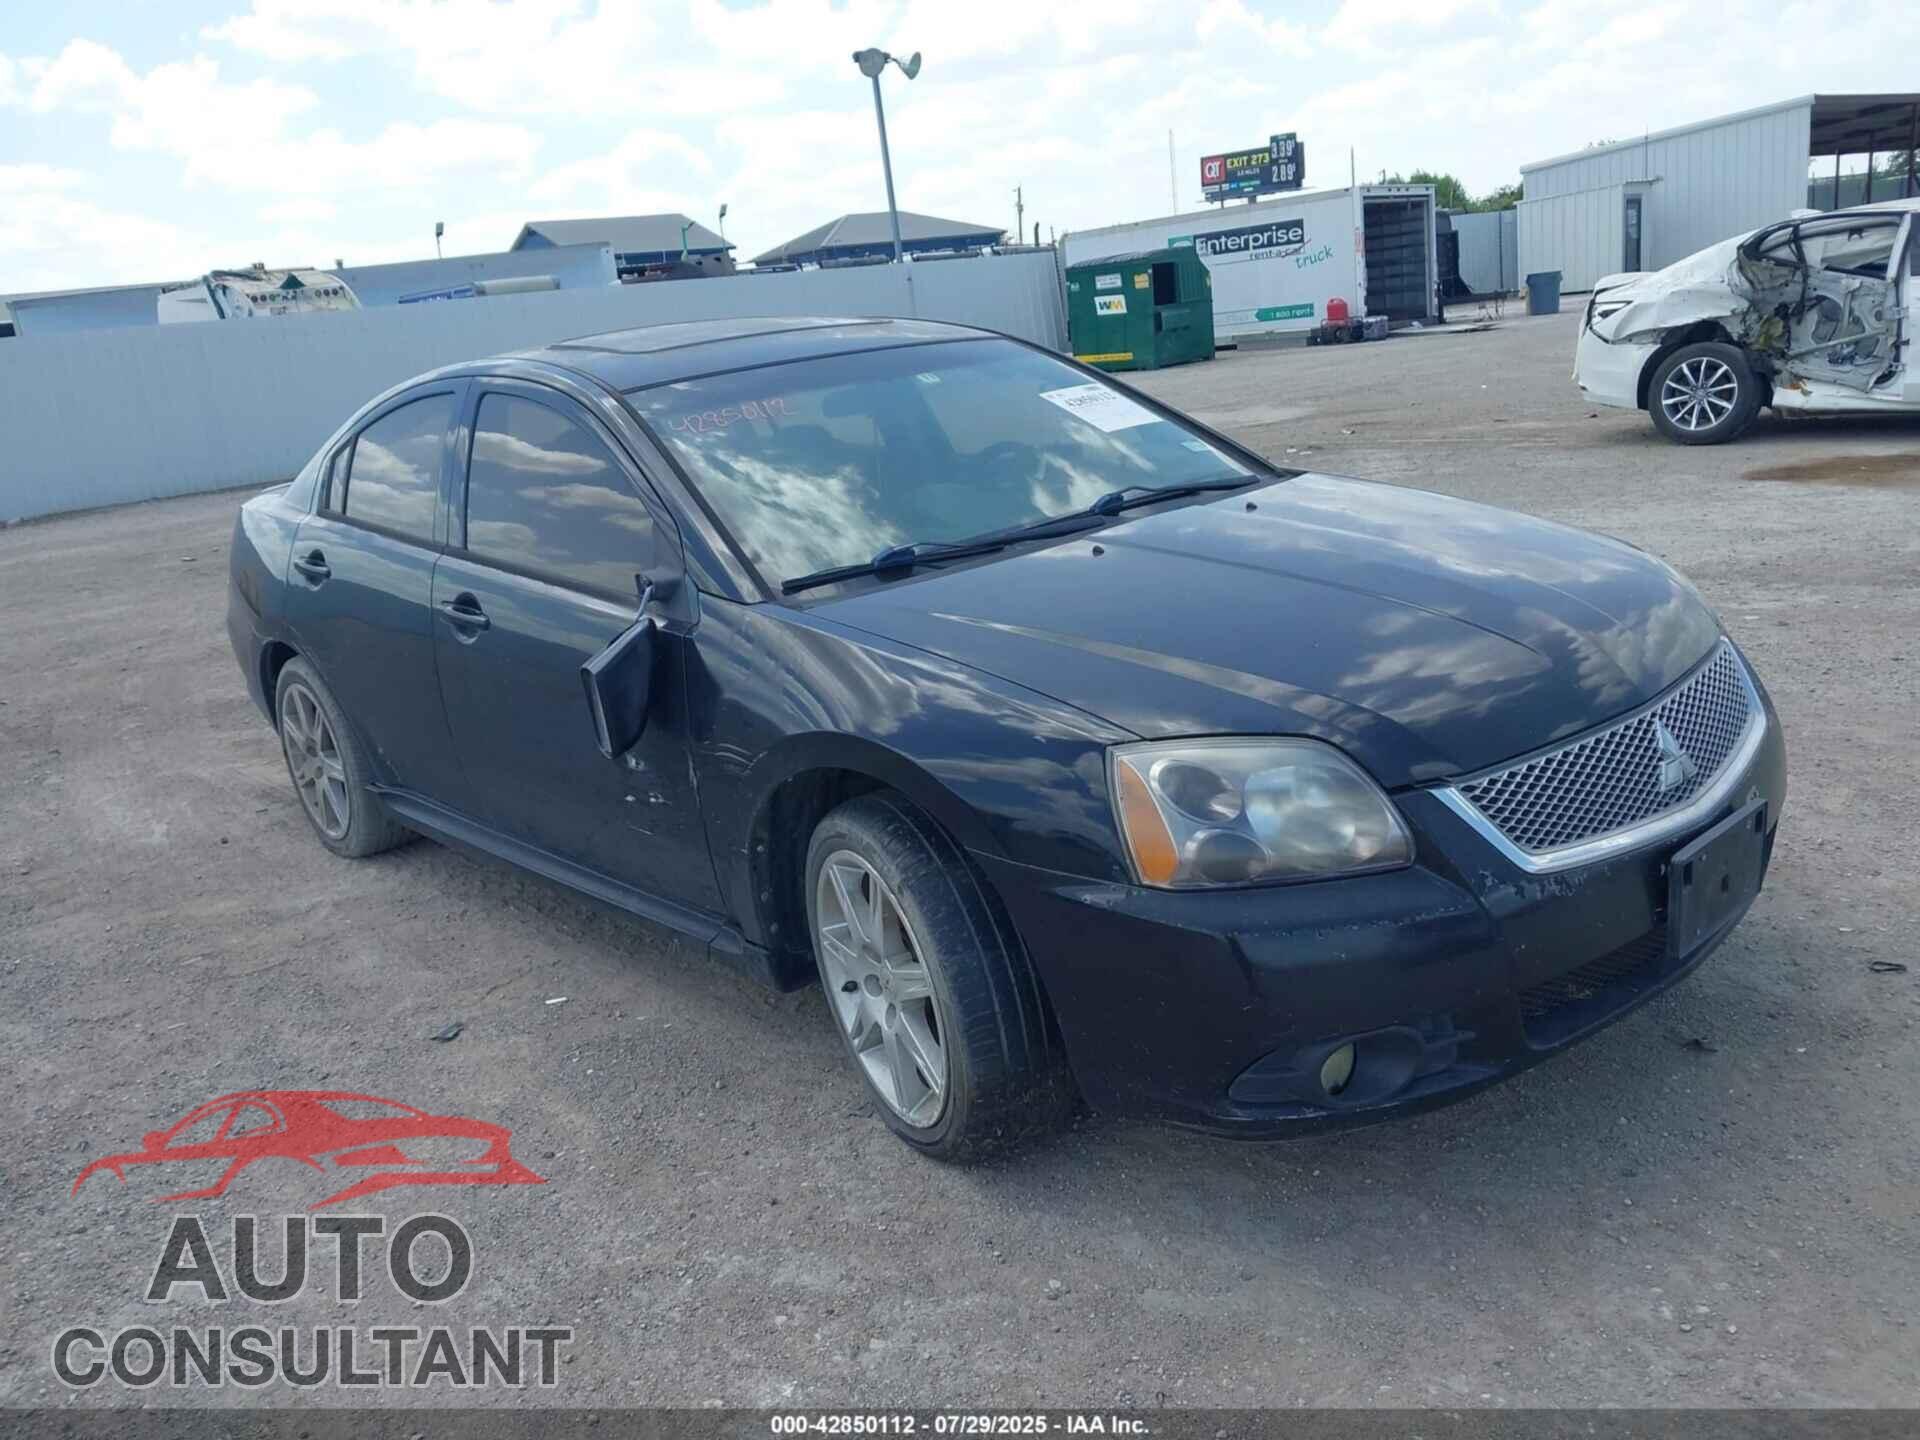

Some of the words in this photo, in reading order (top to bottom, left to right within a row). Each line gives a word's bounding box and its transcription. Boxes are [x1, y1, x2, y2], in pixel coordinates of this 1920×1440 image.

[1226, 156, 1248, 168] EXIT
[1251, 153, 1270, 165] 273
[1205, 161, 1220, 179] QT
[1195, 226, 1303, 255] Enterprise
[1296, 246, 1334, 269] truck
[1099, 300, 1125, 310] WM
